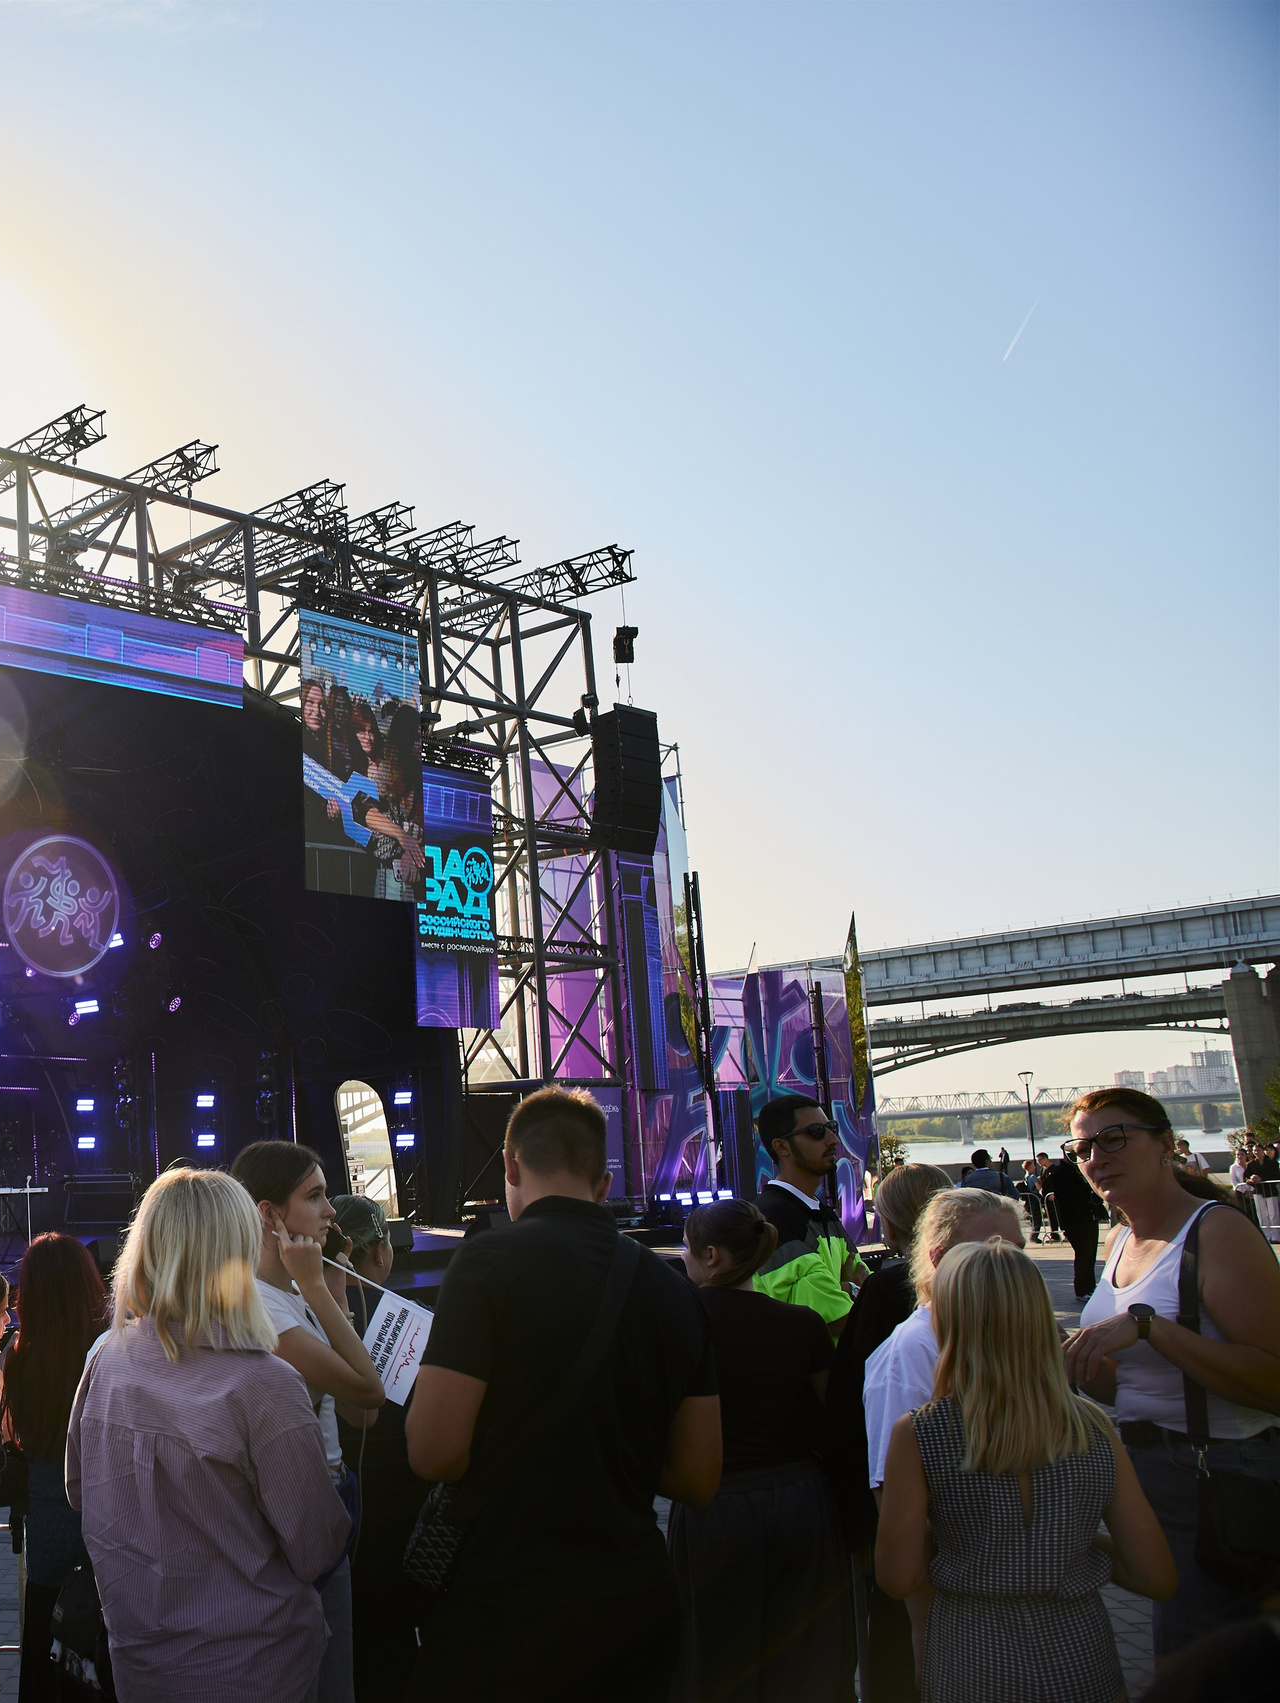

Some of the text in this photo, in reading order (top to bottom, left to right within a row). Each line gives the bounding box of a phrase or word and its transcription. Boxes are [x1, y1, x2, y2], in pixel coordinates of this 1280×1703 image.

[419, 913, 490, 930] РОССИЙСКОГО
[419, 924, 495, 941] СТУДЕНЧЕСТВА
[376, 1312, 395, 1343] ОТКРЫТЫЙ
